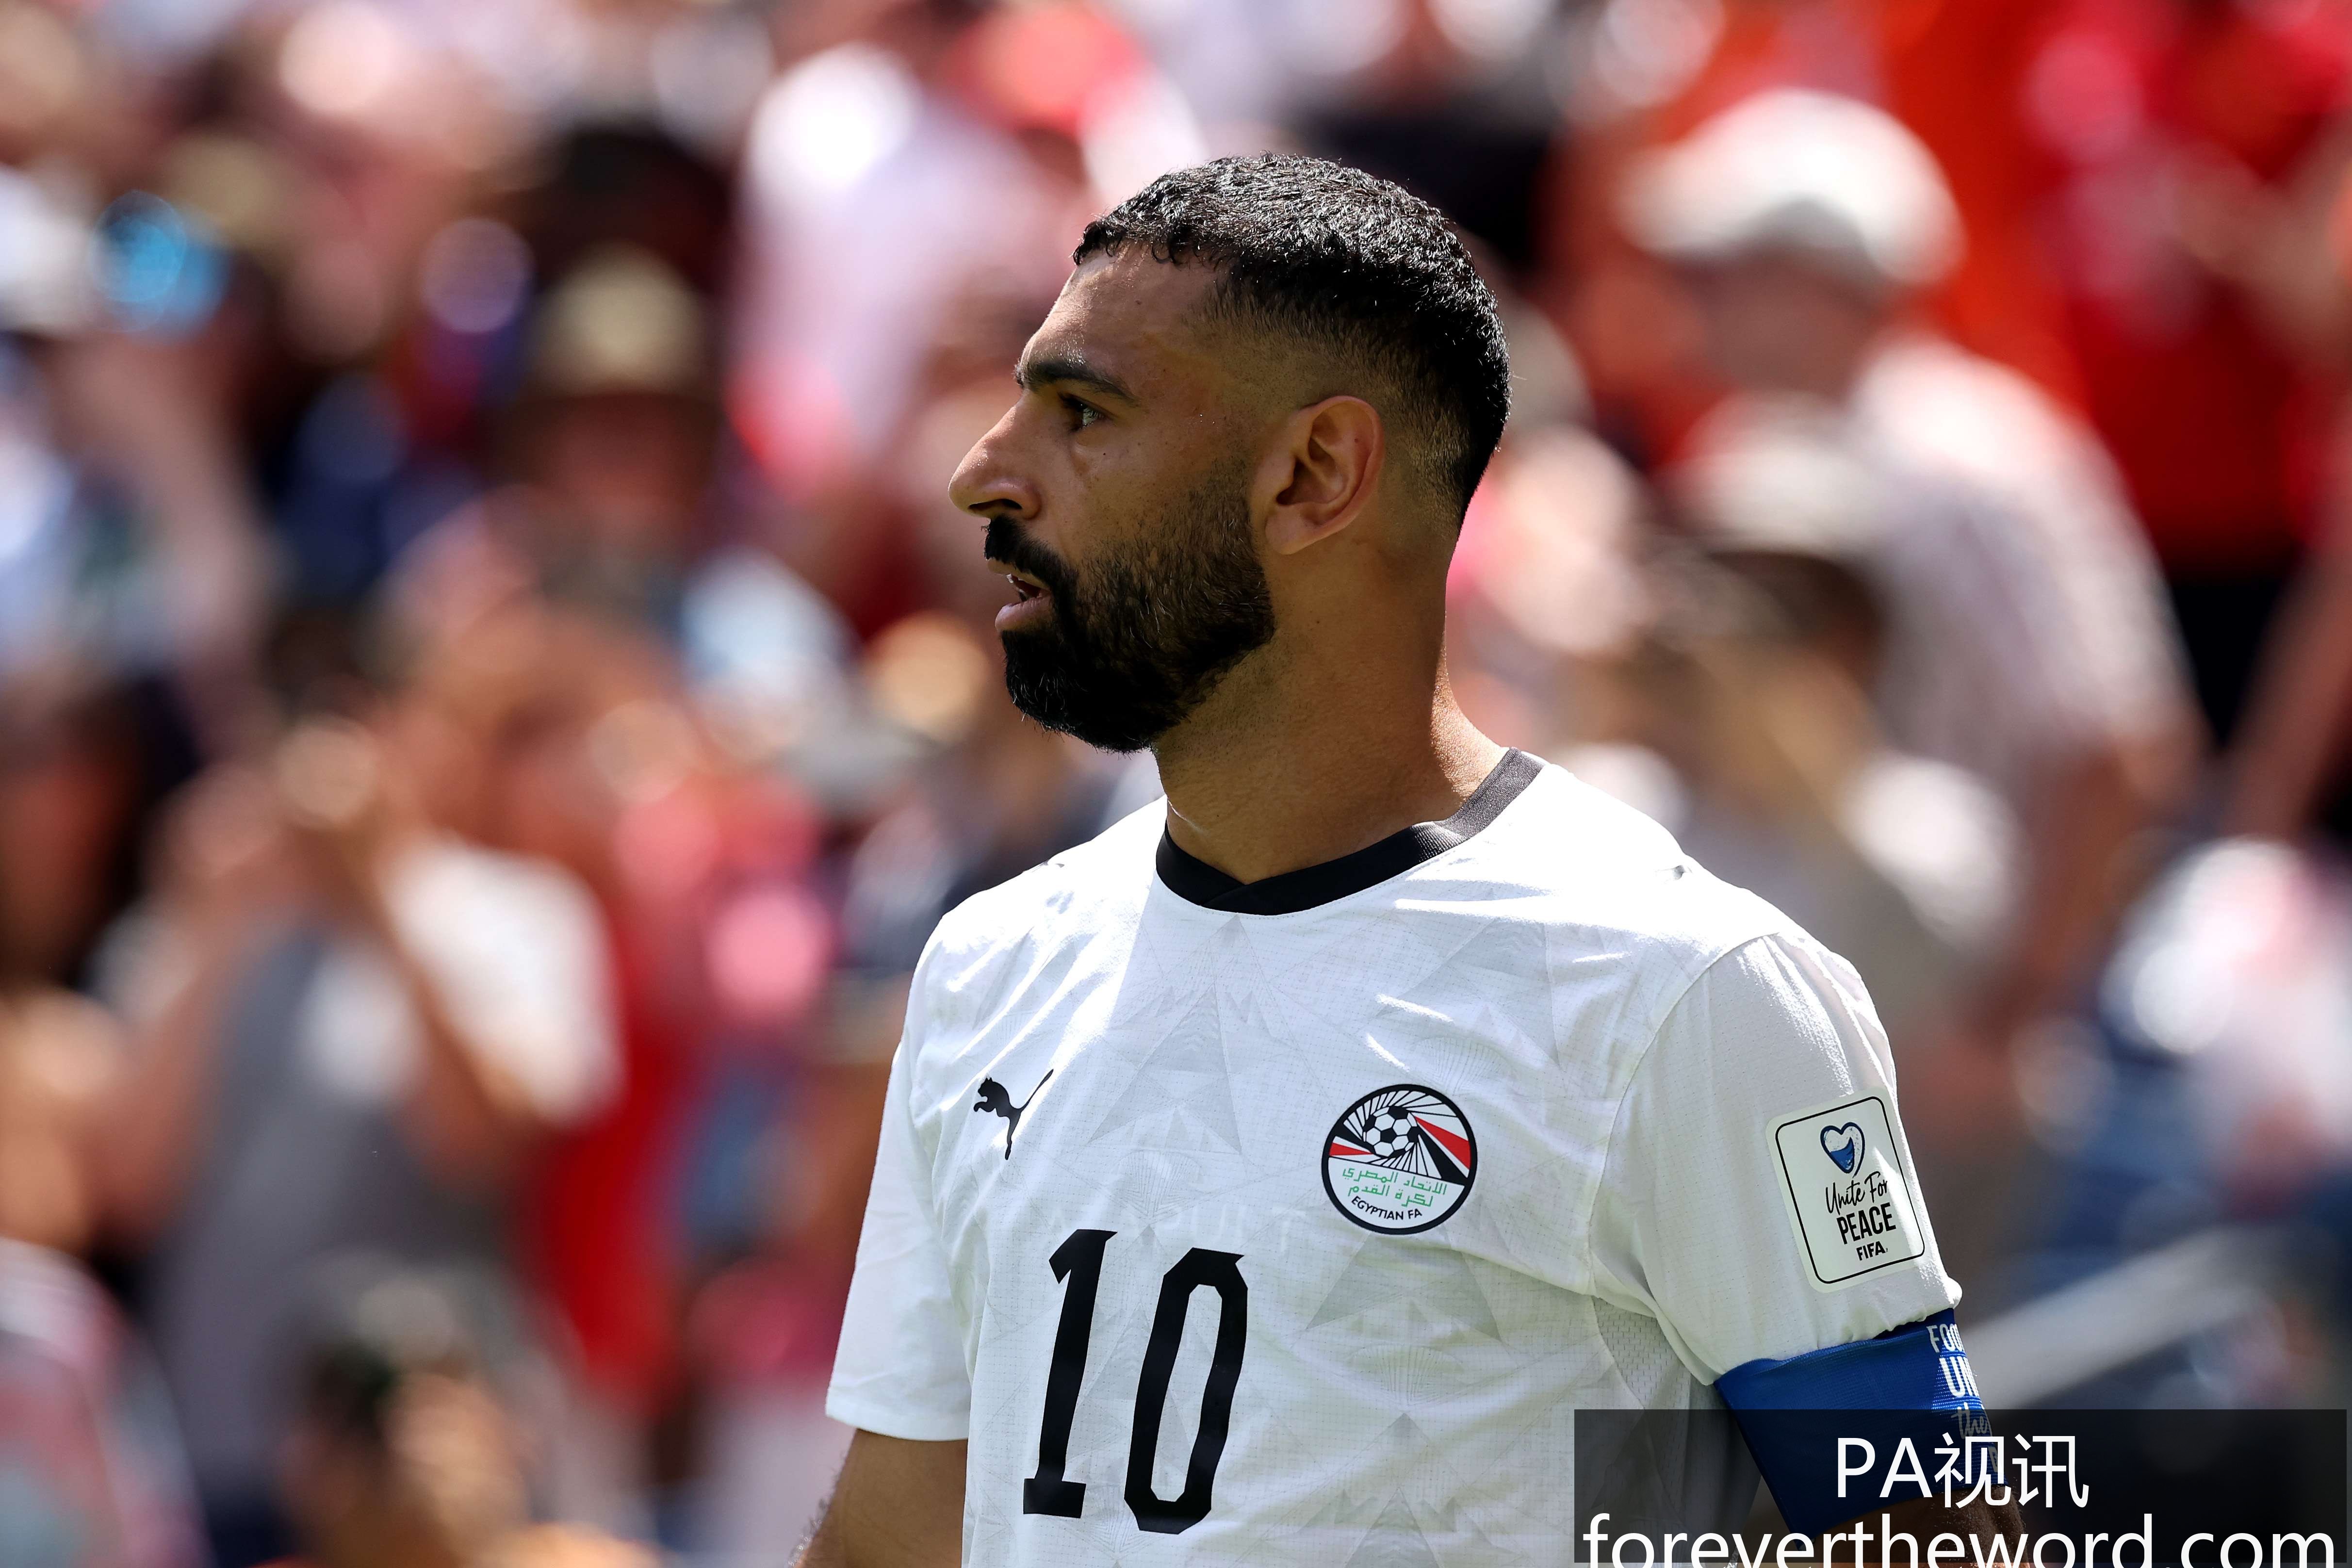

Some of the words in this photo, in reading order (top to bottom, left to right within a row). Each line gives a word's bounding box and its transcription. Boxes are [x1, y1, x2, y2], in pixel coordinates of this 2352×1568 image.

[1342, 1168, 1398, 1184] المصري
[1404, 1176, 1447, 1195] الاتحاد
[1348, 1185, 1390, 1197] القدم
[1395, 1189, 1433, 1208] لكرة
[1825, 1180, 1865, 1215] Unite
[1864, 1171, 1888, 1203] For
[1351, 1196, 1404, 1220] EGYPTIAN
[1408, 1209, 1422, 1219] FA
[1836, 1202, 1896, 1244] PEACE
[1856, 1241, 1886, 1261] FIFA
[1926, 1323, 1965, 1353] FOO
[1023, 1229, 1248, 1535] 10
[1939, 1356, 1980, 1397] UN
